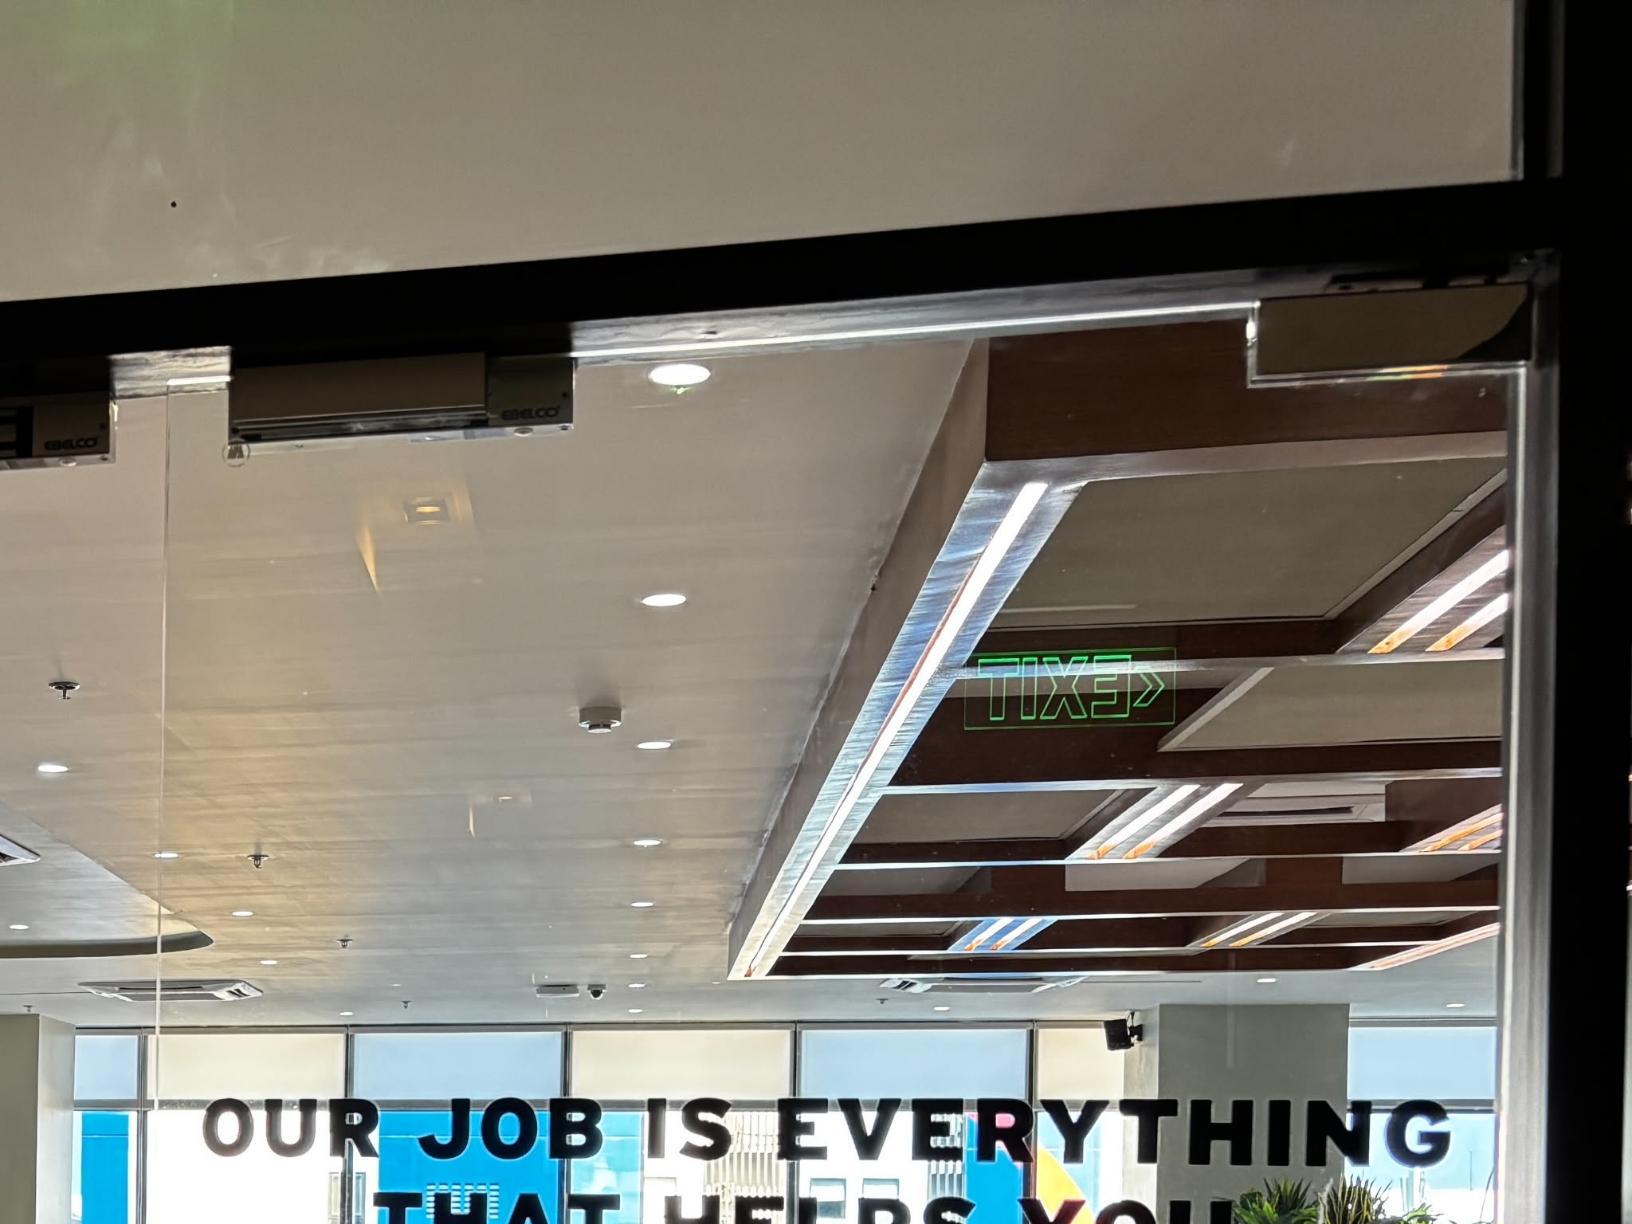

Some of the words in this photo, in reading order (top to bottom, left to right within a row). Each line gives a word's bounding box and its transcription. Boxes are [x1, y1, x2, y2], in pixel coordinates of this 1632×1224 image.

[202, 1097, 380, 1162] OUR
[417, 1097, 603, 1161] JOB
[646, 1098, 733, 1161] IS
[777, 1098, 1452, 1168] EVERYTHING
